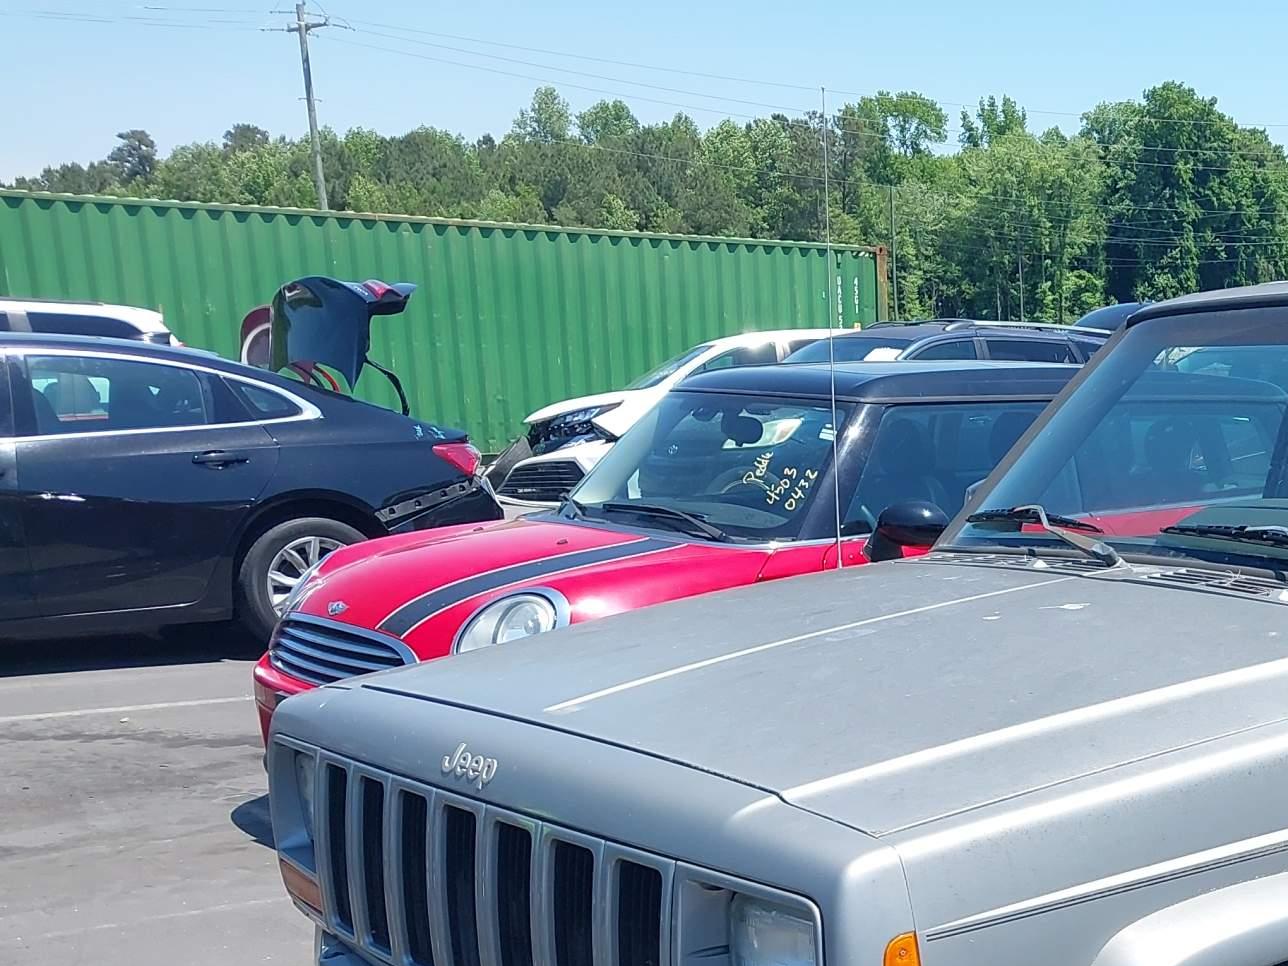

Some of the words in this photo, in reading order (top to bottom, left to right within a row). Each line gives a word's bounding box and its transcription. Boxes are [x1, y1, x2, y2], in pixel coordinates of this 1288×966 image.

[766, 467, 798, 505] 4503
[784, 469, 819, 511] 0432
[441, 742, 498, 790] Jeep
